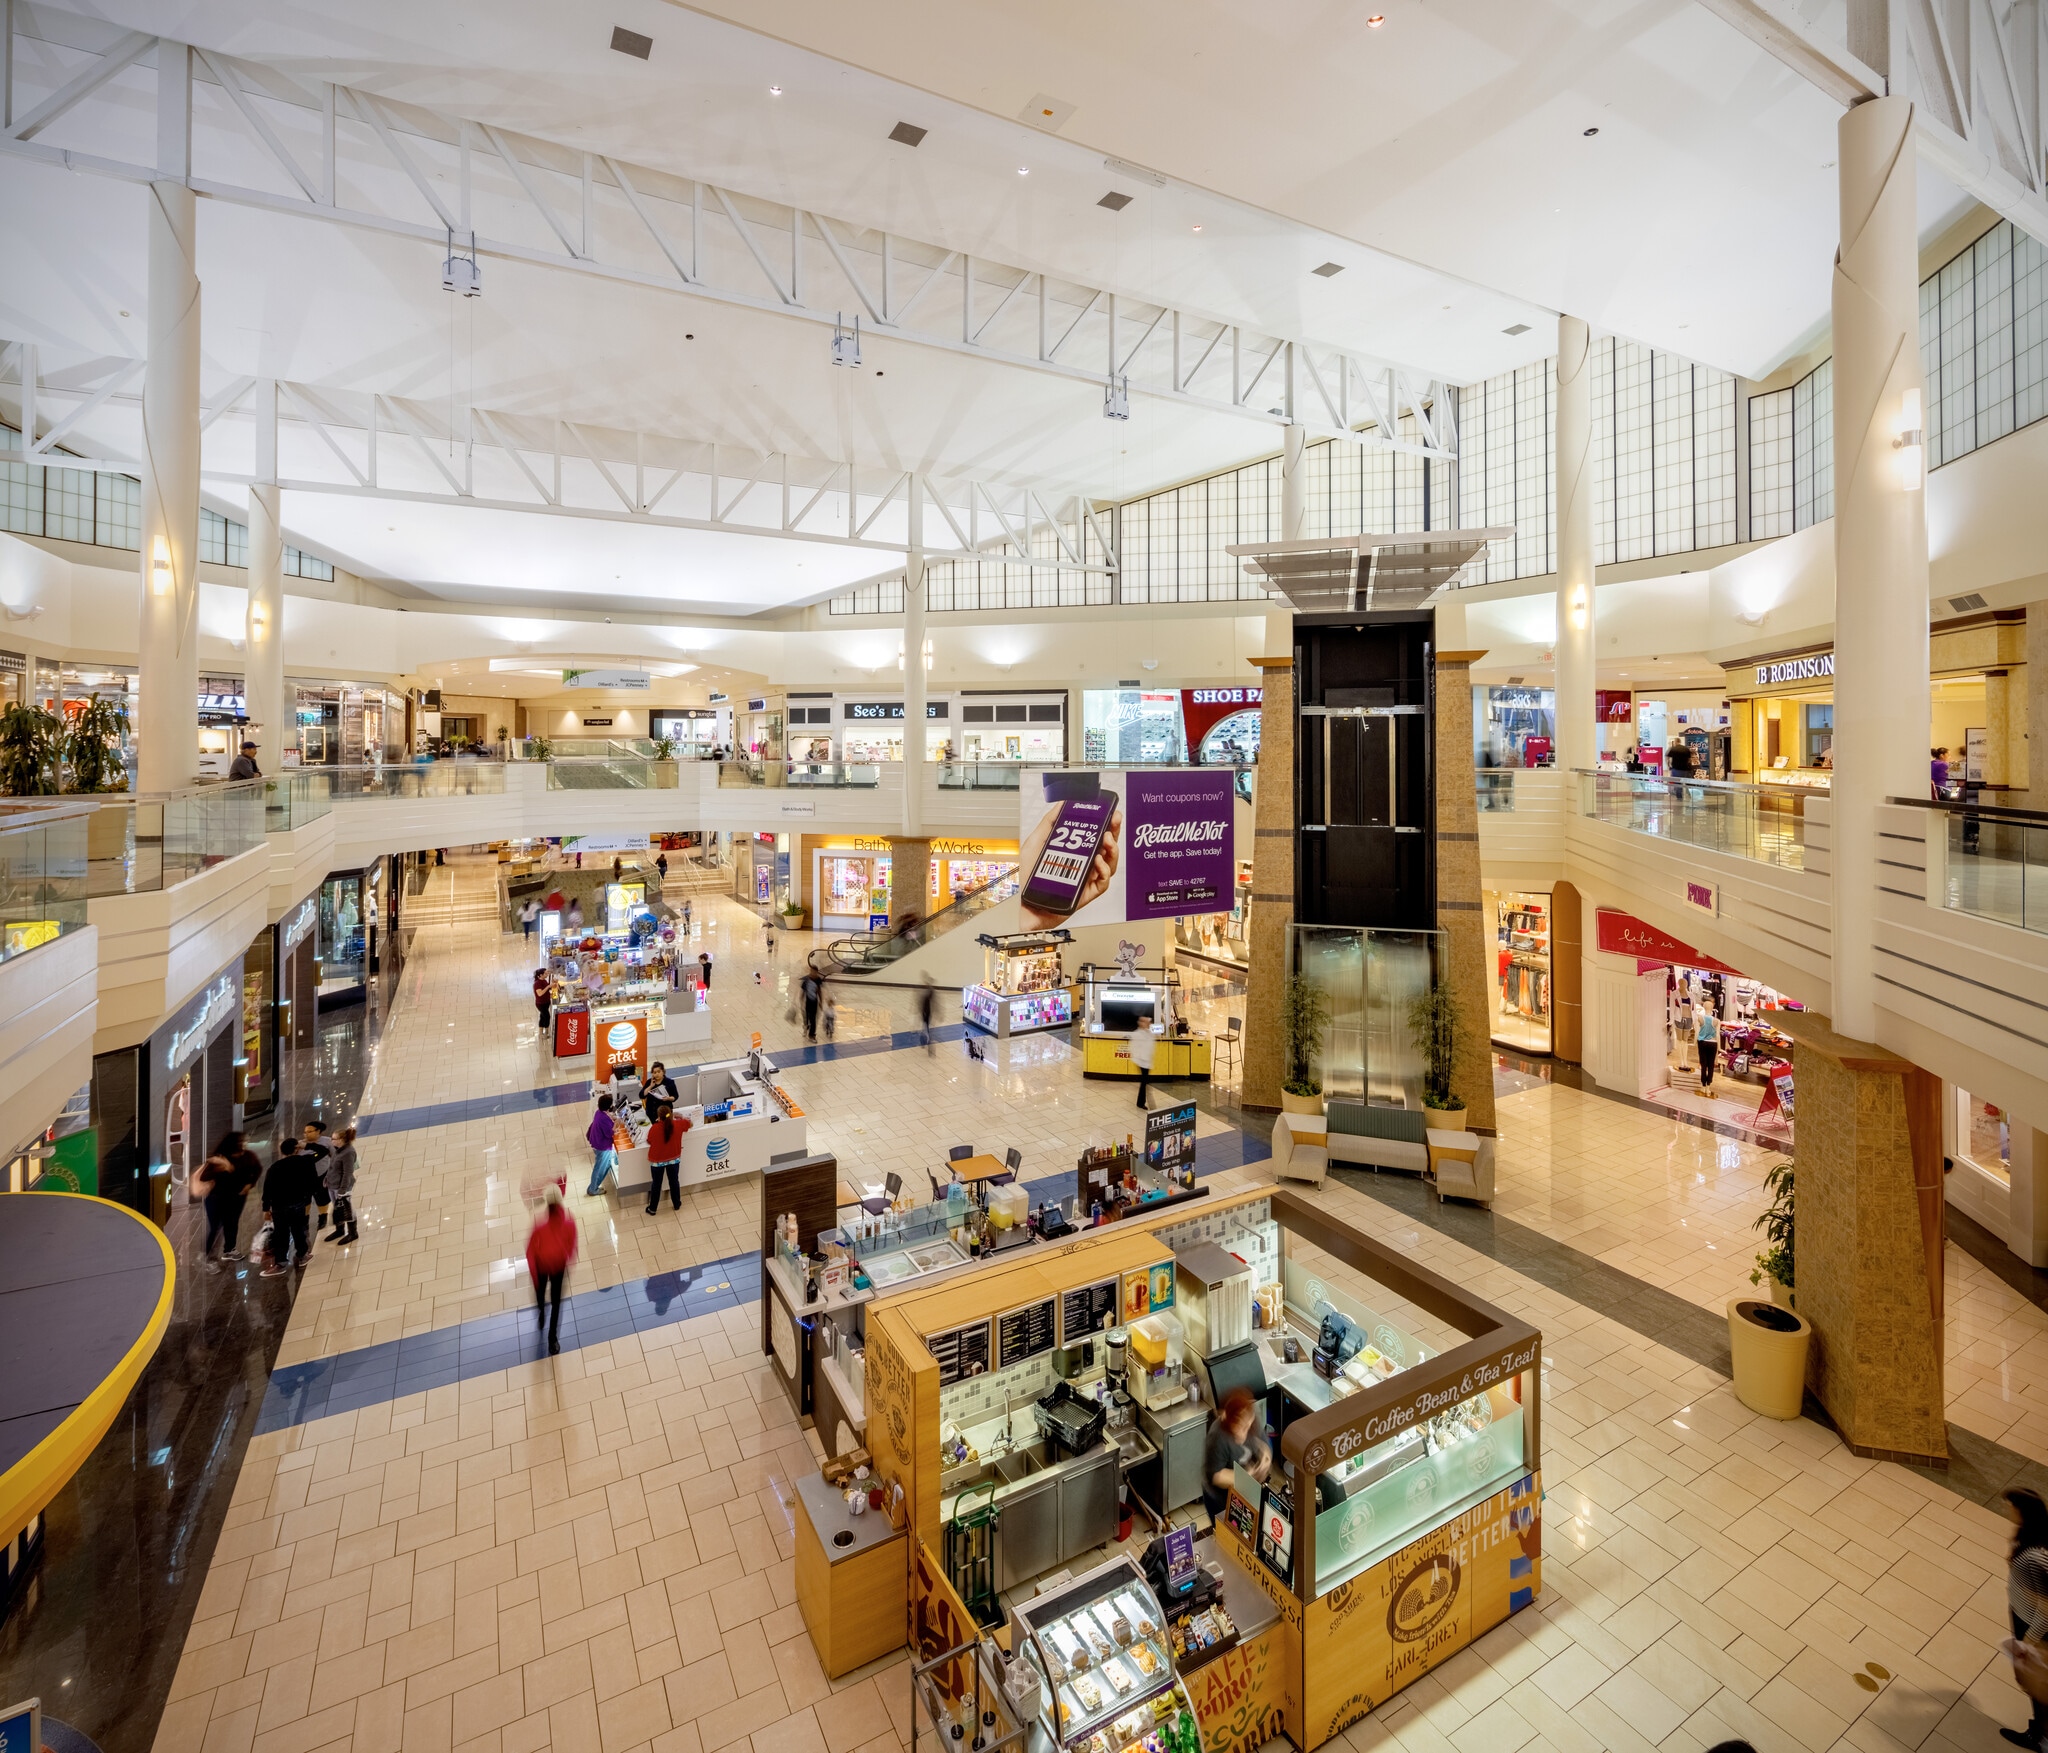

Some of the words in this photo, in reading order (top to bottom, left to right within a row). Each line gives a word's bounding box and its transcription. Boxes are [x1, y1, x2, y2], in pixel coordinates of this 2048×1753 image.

[1755, 667, 1767, 685] JB
[1770, 655, 1834, 682] ROBINSON
[1193, 690, 1242, 703] SHOE
[854, 705, 885, 718] See's
[1111, 702, 1145, 719] NIKE
[1142, 793, 1163, 803] Want
[1166, 792, 1201, 804] coupons
[1203, 791, 1224, 801] now?
[1064, 820, 1080, 828] SAVE
[1133, 821, 1229, 848] RetailMeNot
[855, 838, 886, 851] Bath
[937, 841, 984, 854] Works
[1144, 851, 1156, 859] Get
[1157, 850, 1168, 858] the
[1169, 850, 1184, 859] app.
[1186, 848, 1201, 857] Save
[1203, 847, 1222, 857] today!
[1687, 882, 1712, 909] PINK
[1618, 928, 1654, 948] life
[1660, 940, 1675, 948] is
[607, 1048, 638, 1064] at&t
[706, 1159, 730, 1173] at&t
[1332, 1428, 1361, 1458] The
[1365, 1406, 1414, 1441] Coffee
[1416, 1385, 1460, 1416] Bean
[1460, 1373, 1473, 1394] &
[1474, 1364, 1500, 1386] Tea
[1501, 1341, 1538, 1373] Leaf
[1498, 1478, 1527, 1512] TEA
[1449, 1515, 1510, 1573] BETTER
[1385, 1647, 1421, 1681] EARL
[1427, 1617, 1460, 1652] GREY
